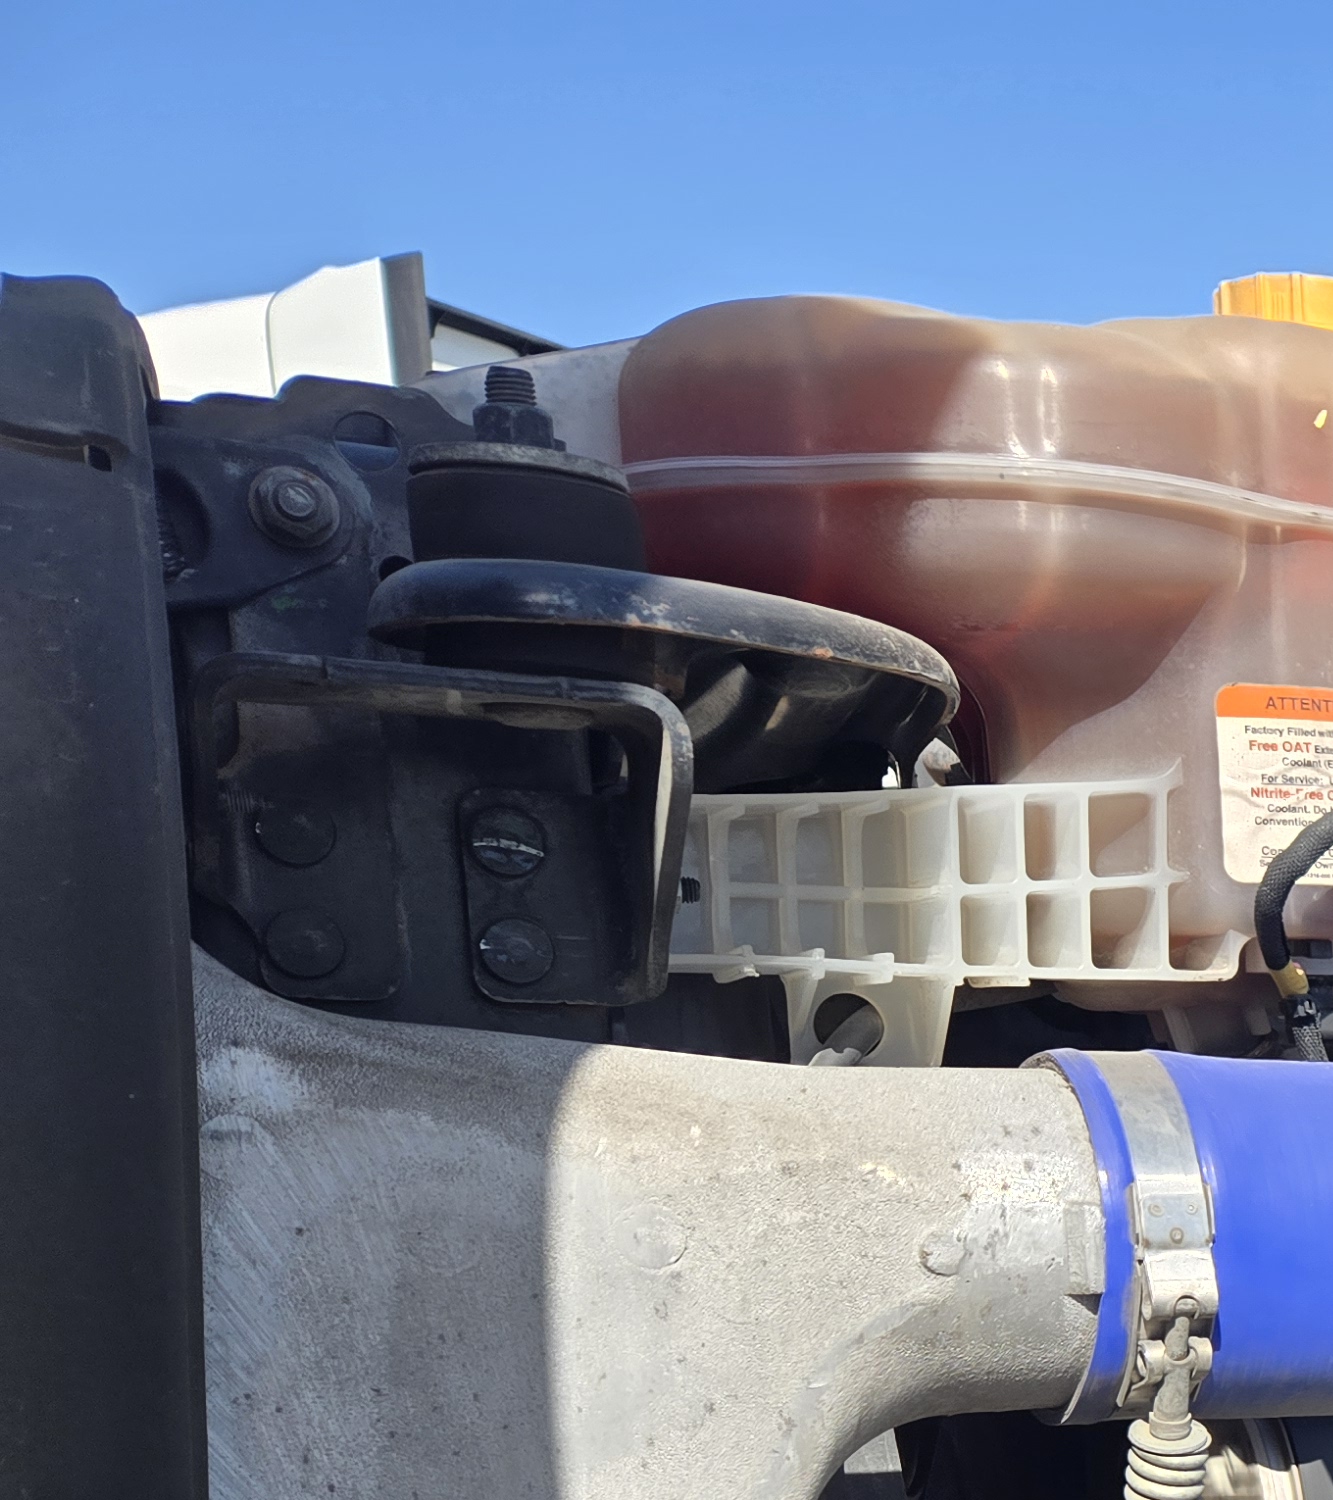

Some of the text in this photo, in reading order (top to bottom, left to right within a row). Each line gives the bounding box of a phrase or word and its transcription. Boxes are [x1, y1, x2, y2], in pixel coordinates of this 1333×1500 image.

[1243, 725, 1284, 737] Factory
[1287, 727, 1316, 737] Filled
[1249, 740, 1279, 751] Free
[1282, 741, 1312, 753] OAT
[1282, 757, 1322, 767] Coolant
[1261, 774, 1278, 784] For
[1281, 774, 1323, 786] Service:
